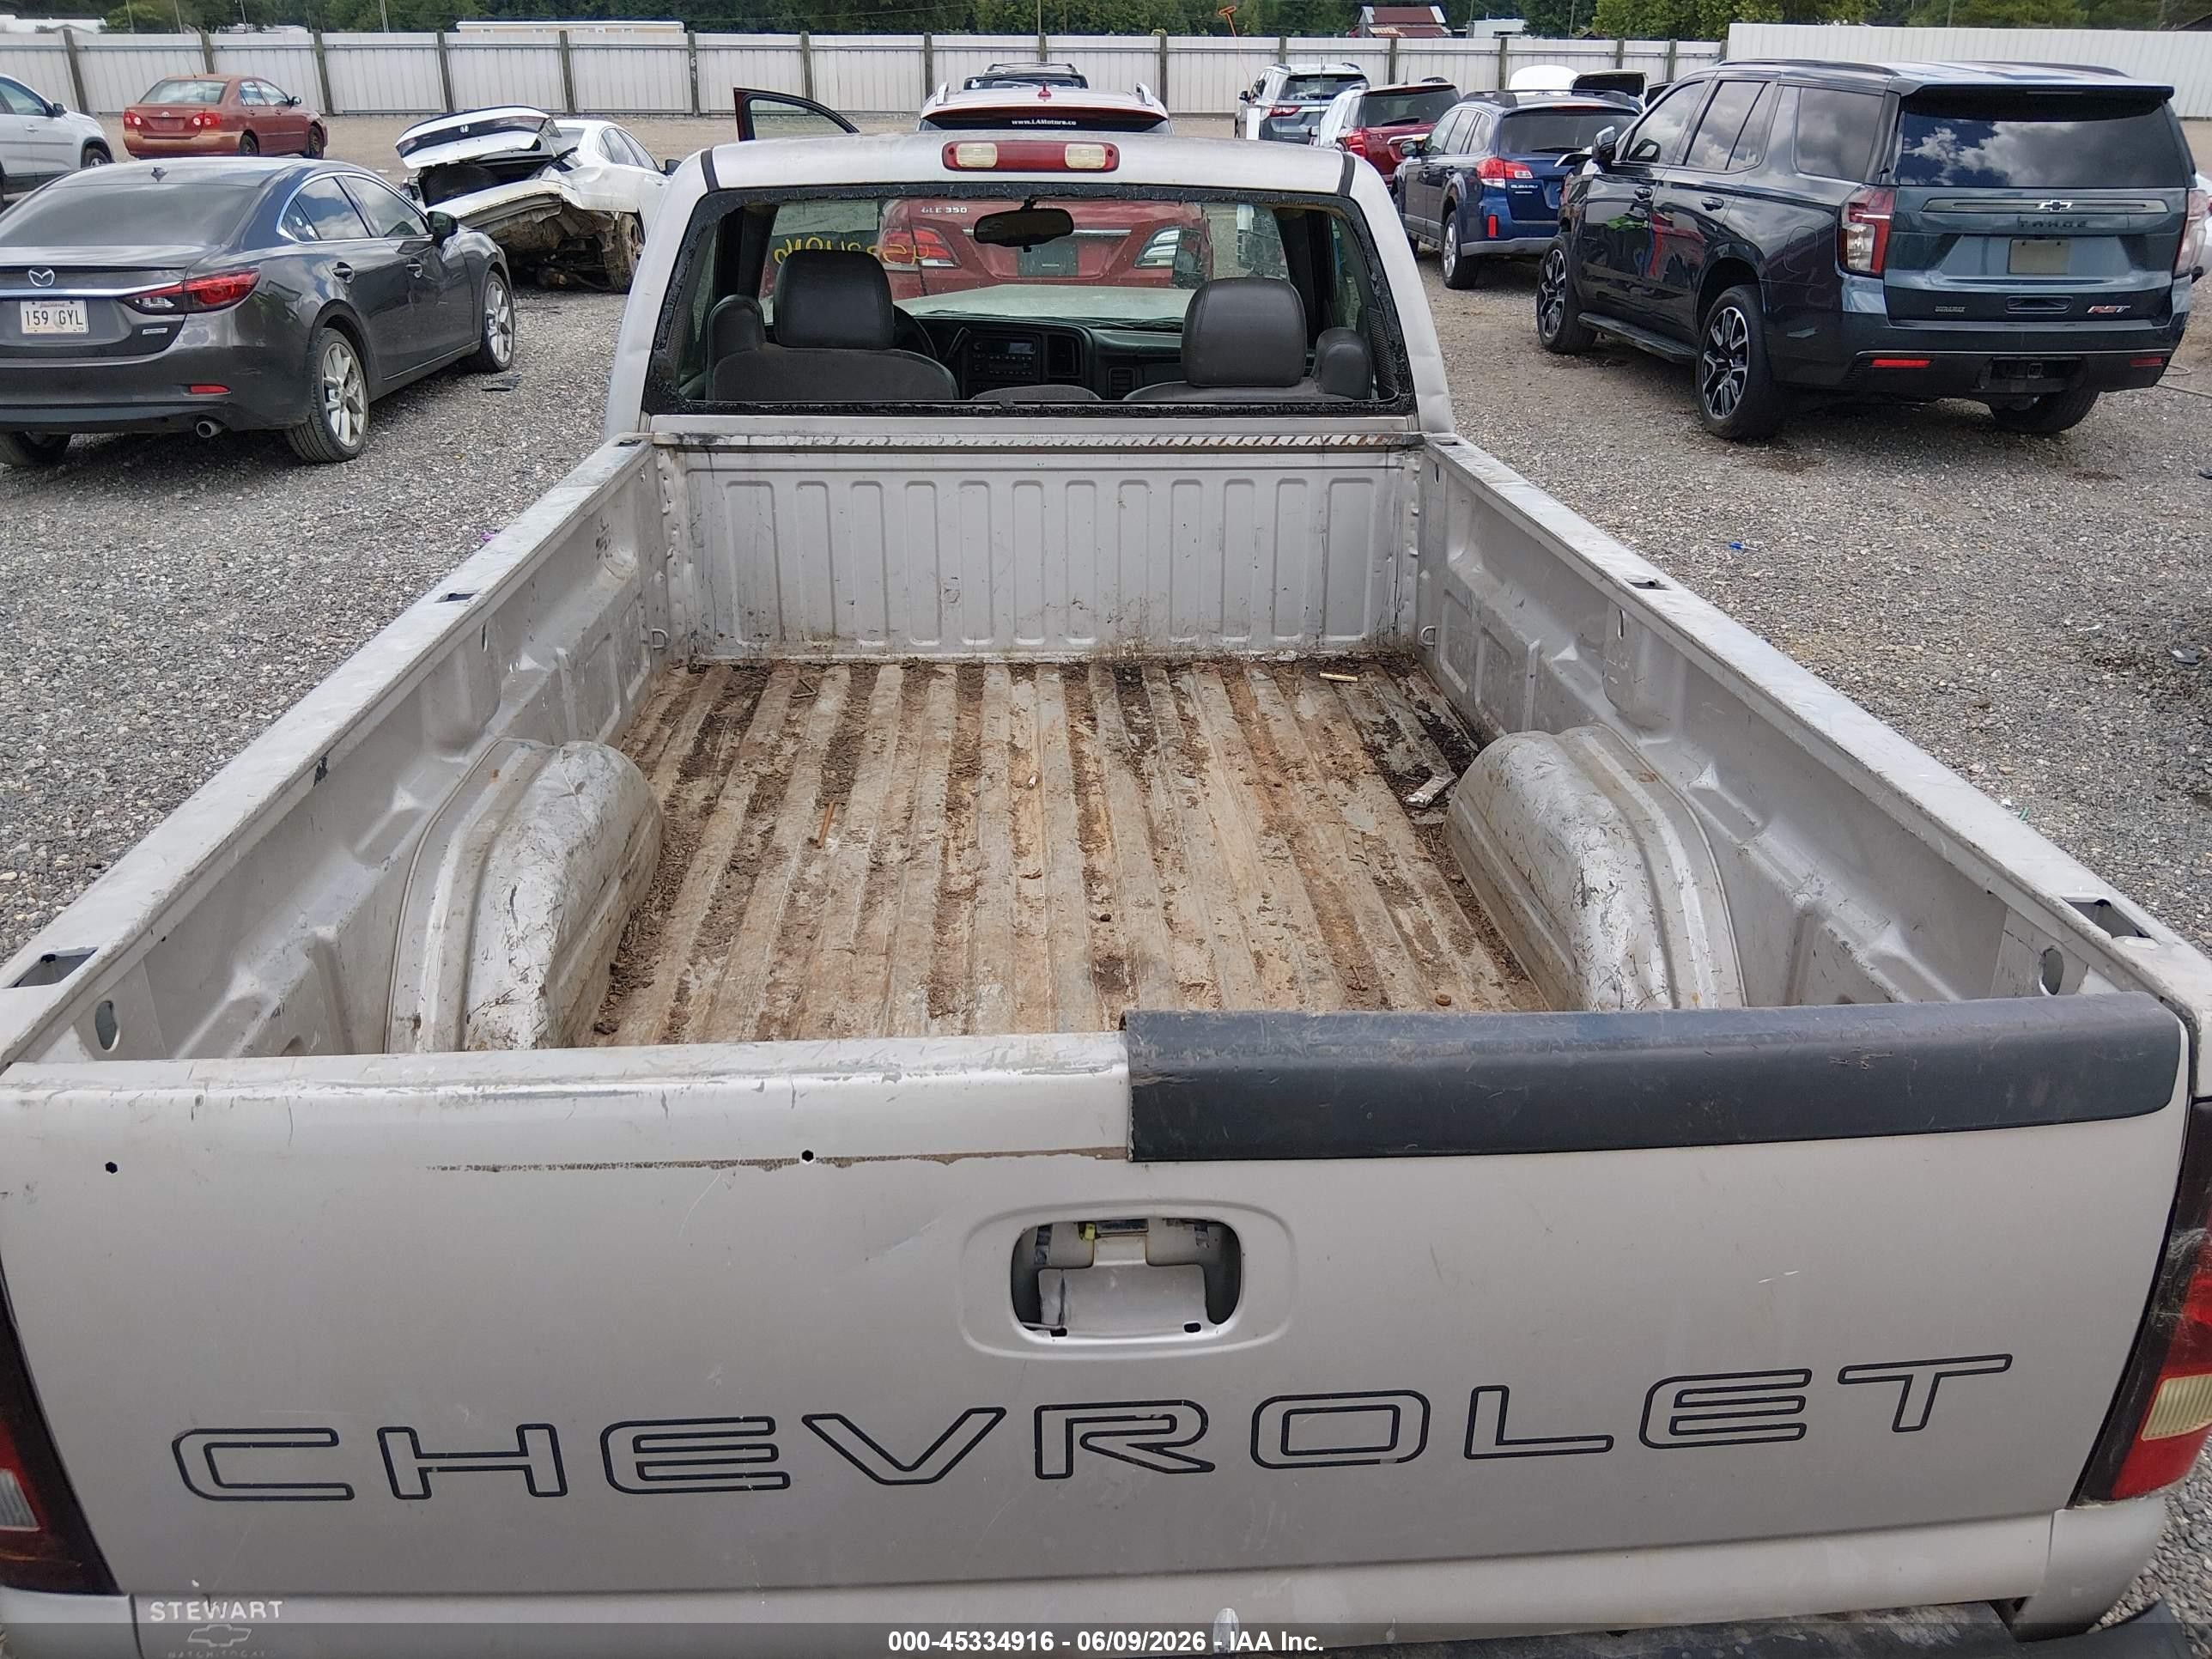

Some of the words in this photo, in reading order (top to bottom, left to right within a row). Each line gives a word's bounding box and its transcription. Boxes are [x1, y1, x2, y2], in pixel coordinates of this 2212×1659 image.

[26, 310, 49, 326] 159
[58, 310, 83, 325] GYL
[2087, 305, 2131, 313] RST
[172, 1354, 2013, 1501] CHEVROLET
[149, 1601, 283, 1622] STEWART
